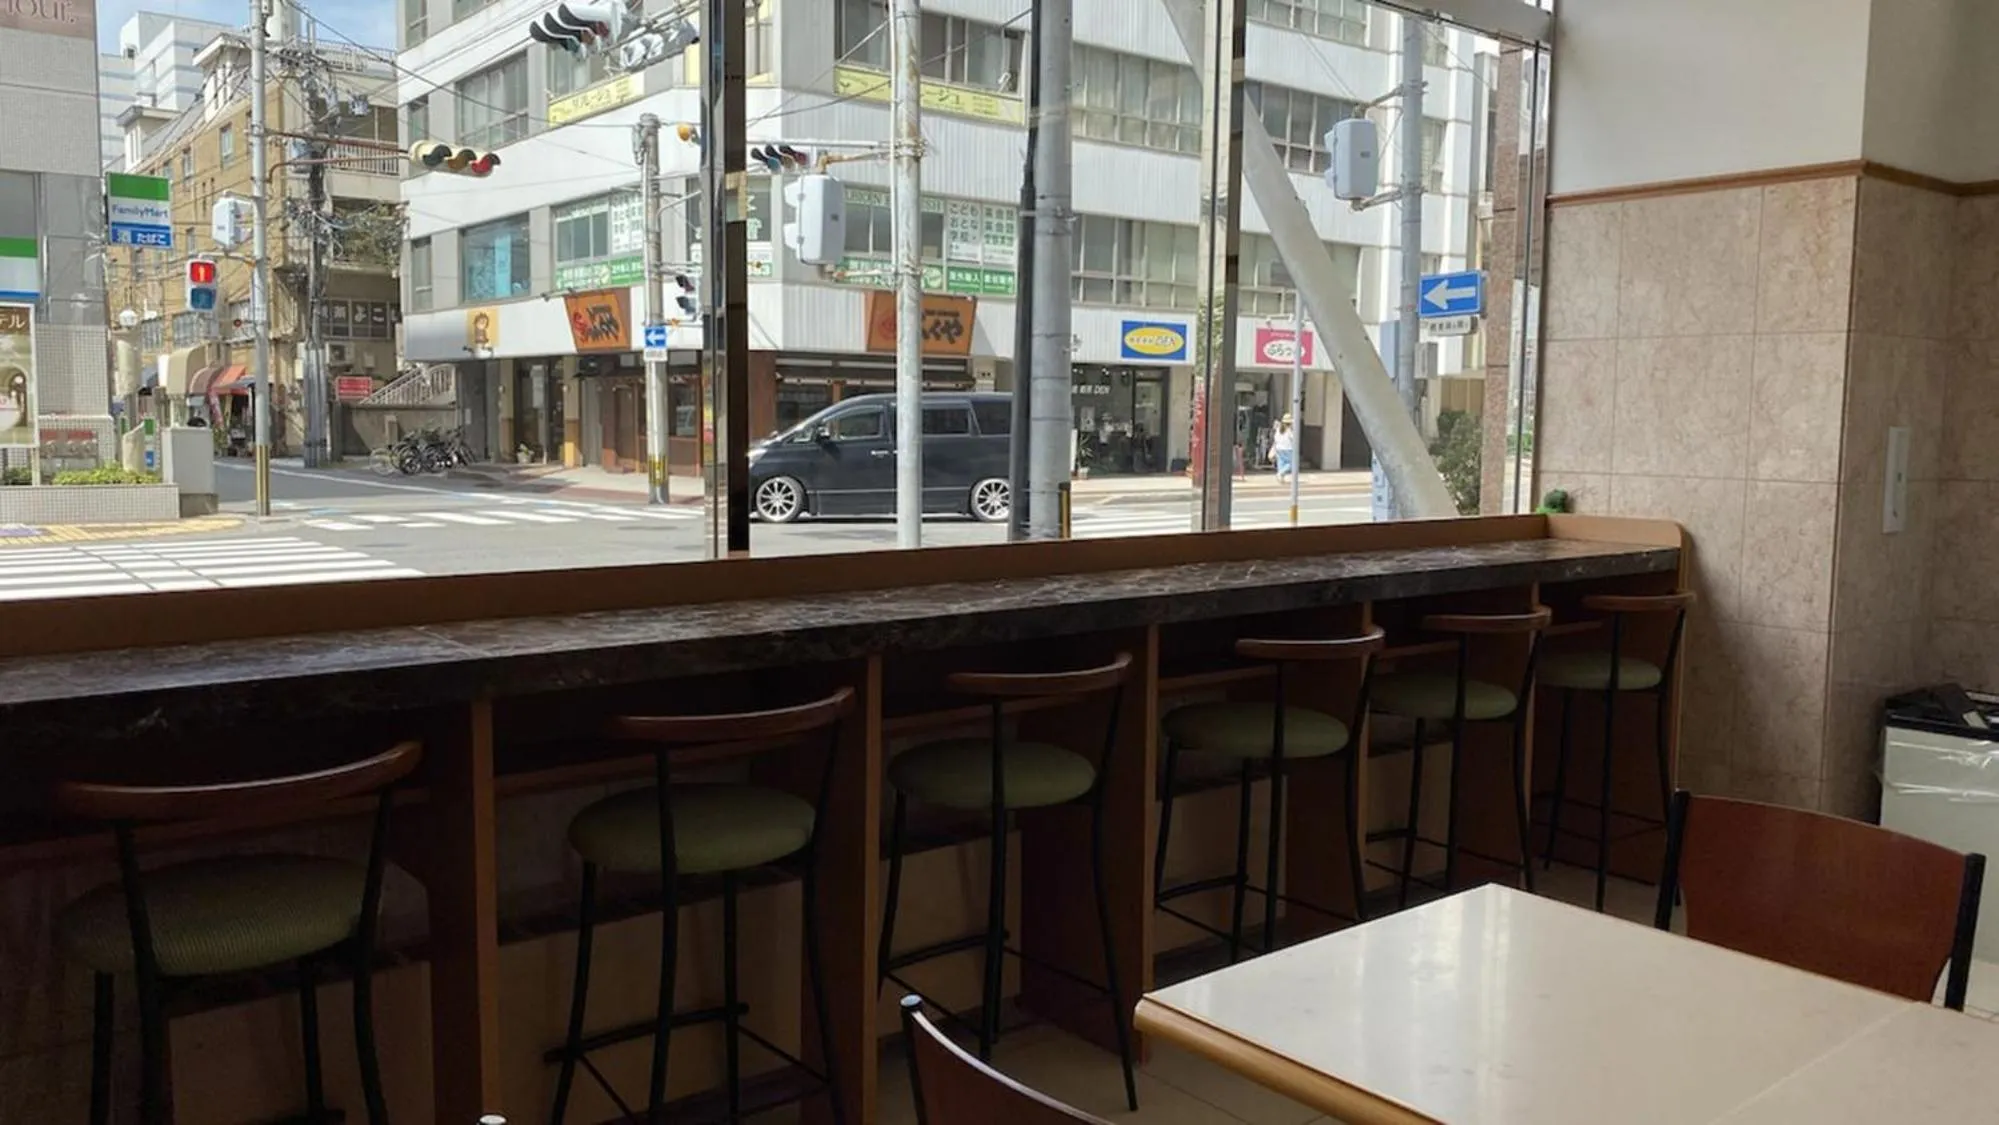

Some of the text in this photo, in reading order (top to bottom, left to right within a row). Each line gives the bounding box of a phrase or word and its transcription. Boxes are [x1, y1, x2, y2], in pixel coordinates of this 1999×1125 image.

[111, 203, 169, 219] FamilyMart
[136, 232, 167, 245] たばこ
